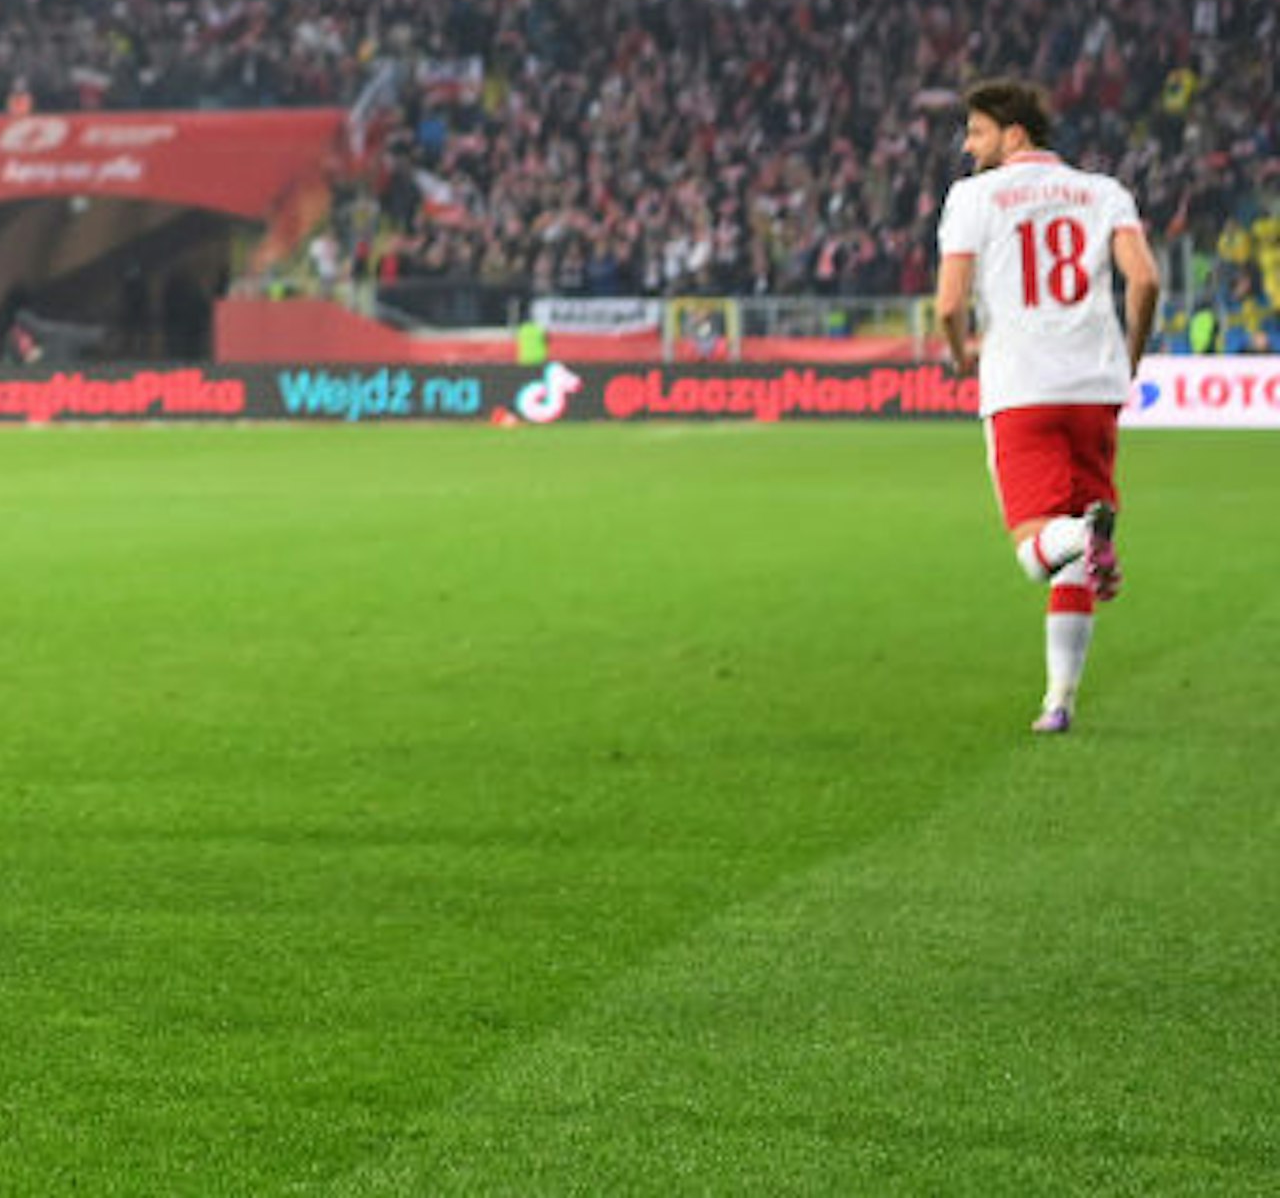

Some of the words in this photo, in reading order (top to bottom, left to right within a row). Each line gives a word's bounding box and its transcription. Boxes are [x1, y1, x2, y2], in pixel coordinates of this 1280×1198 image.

[1015, 217, 1090, 308] 18
[277, 366, 414, 422] Wejdź
[423, 377, 482, 413] na
